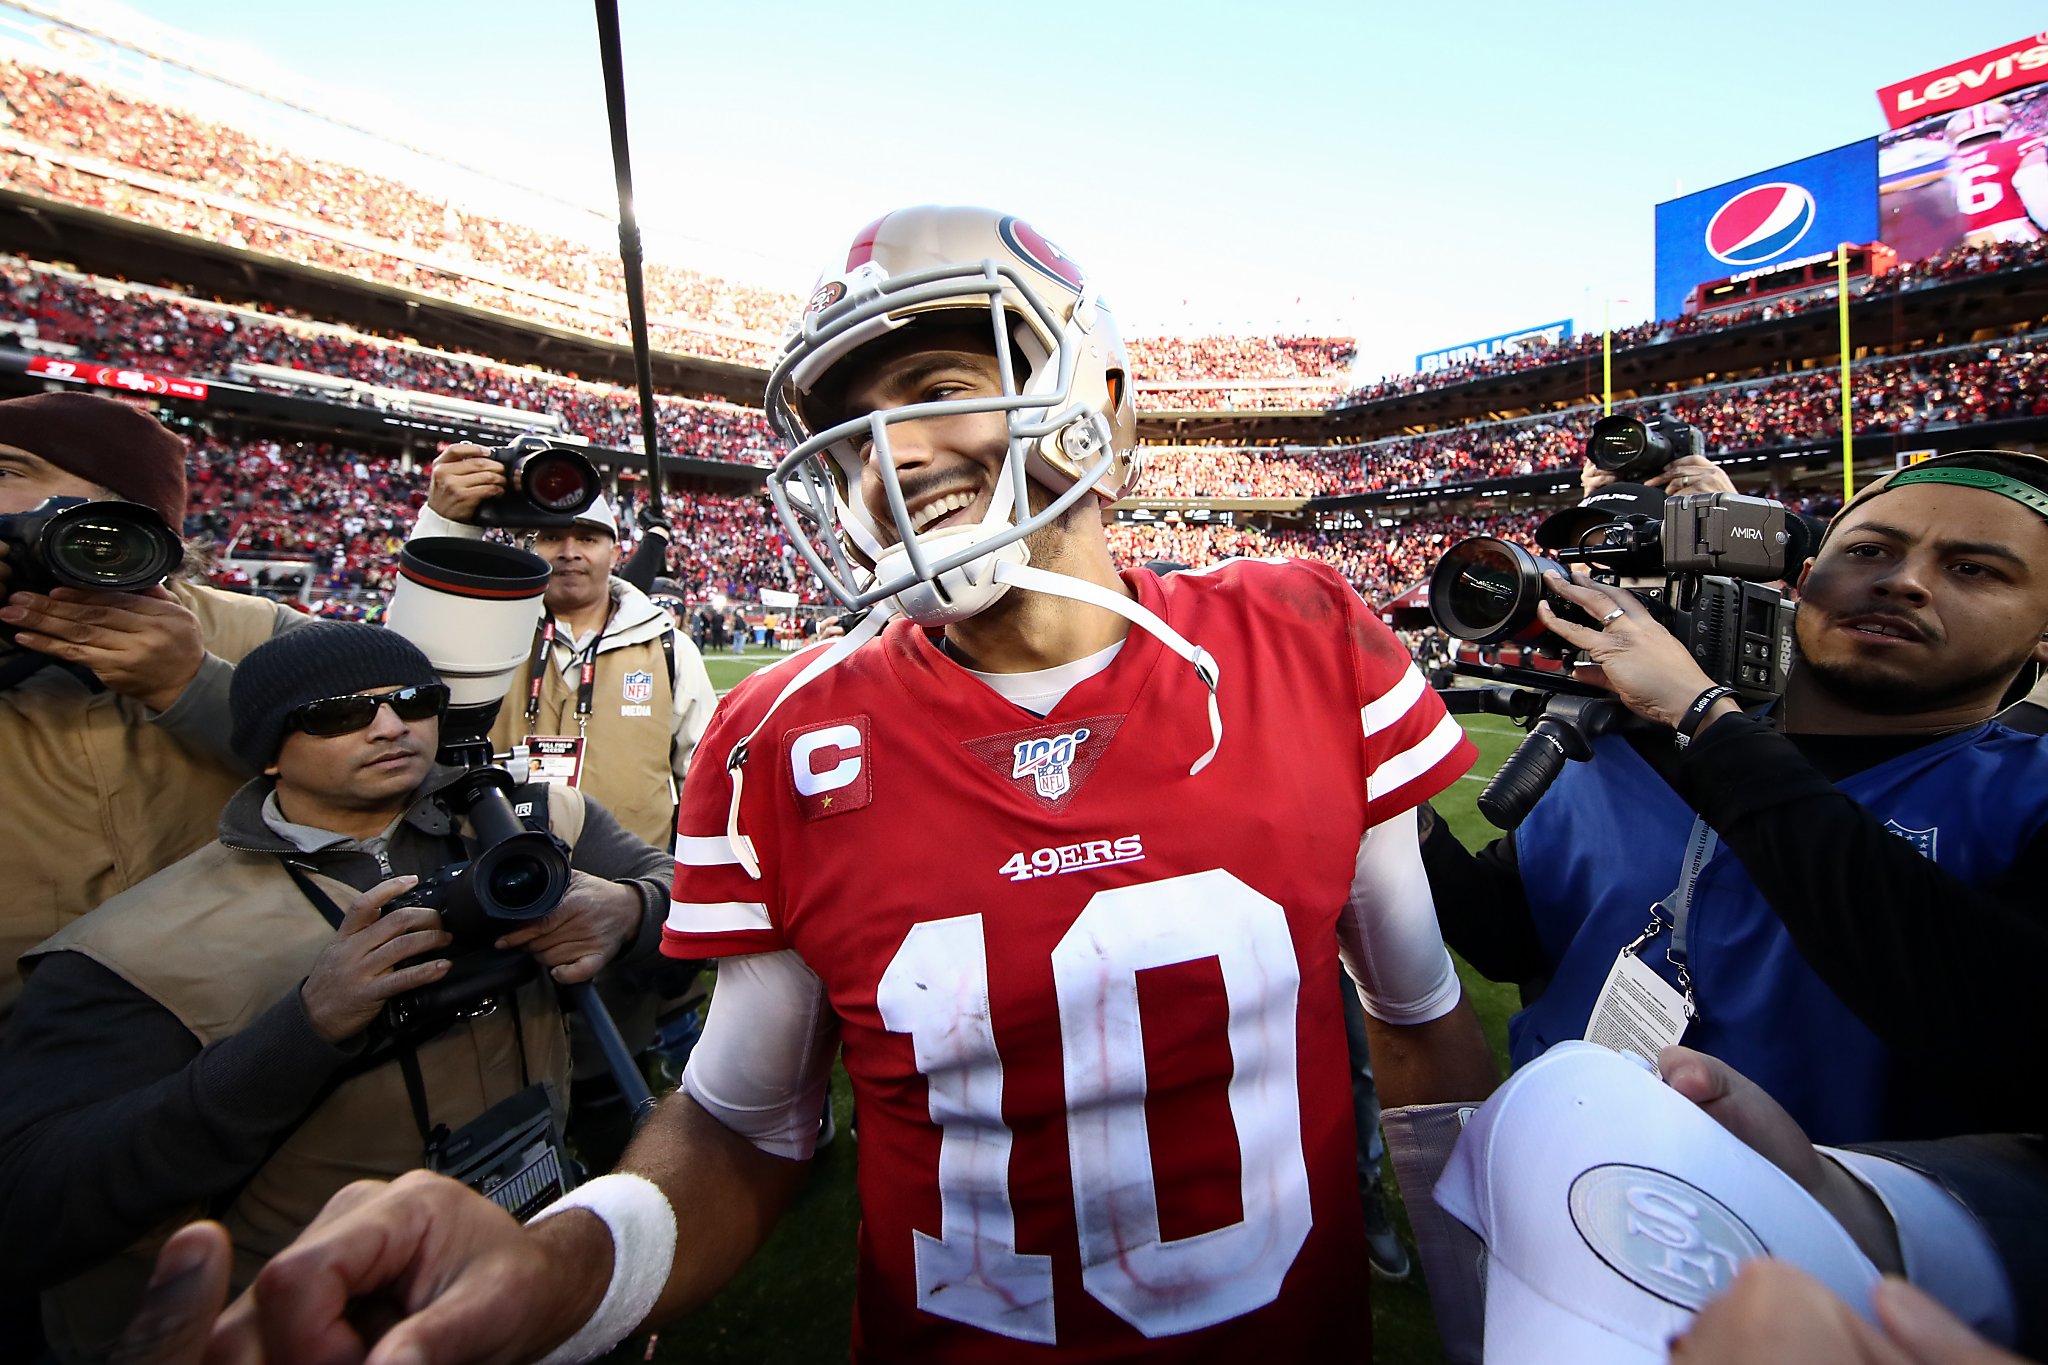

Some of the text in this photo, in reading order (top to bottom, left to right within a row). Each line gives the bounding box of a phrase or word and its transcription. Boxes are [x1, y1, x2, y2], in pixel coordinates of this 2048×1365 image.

[1730, 526, 1763, 541] AMIRA
[1779, 635, 1793, 677] ARRI
[627, 684, 649, 697] NFL
[620, 705, 652, 717] MEDIA
[790, 724, 862, 797] C
[1018, 737, 1073, 767] 100
[1042, 773, 1063, 791] NFL
[998, 833, 1146, 883] 49ERS
[1691, 846, 1706, 876] FOOTBALL
[1685, 876, 1698, 908] NATIONAL
[876, 867, 1314, 1346] 10
